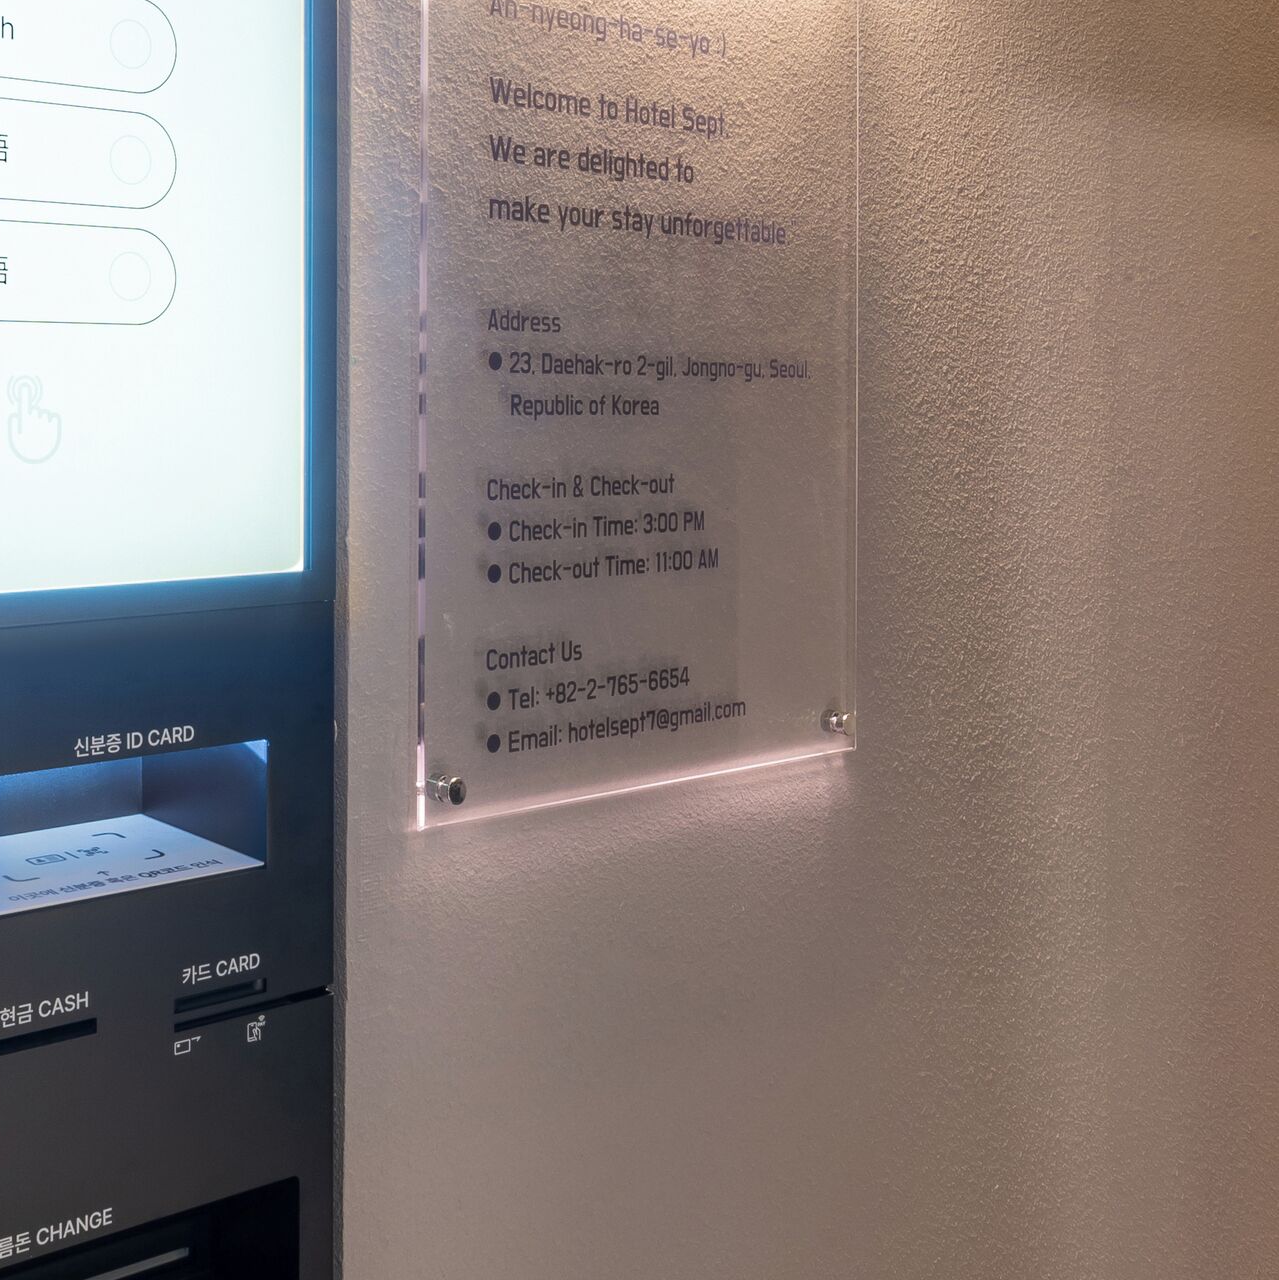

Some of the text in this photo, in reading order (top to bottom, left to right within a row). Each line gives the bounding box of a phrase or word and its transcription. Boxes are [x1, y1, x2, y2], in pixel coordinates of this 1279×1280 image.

[489, 76, 591, 117] Welcome
[598, 93, 619, 121] to
[625, 97, 676, 129] Hotel
[489, 134, 694, 183] We are delighted to
[489, 196, 550, 224] make
[557, 204, 605, 232] your
[612, 205, 654, 239] stay
[488, 308, 562, 333] Address
[541, 352, 632, 376] Daehak-ro
[510, 393, 660, 421] Republic of Korea
[487, 473, 676, 501] Check-in & Check-out
[508, 510, 706, 542] Check-in Time: 3:00 PM
[508, 548, 719, 584] Check-out Time: 11:00 AM
[486, 640, 583, 671] Contact Us
[508, 666, 690, 710] Tel: +82-2-765-6654
[74, 725, 195, 758] 신분증 ID CARD
[508, 700, 747, 753] Email: hotelsept7@gmail.com
[182, 953, 260, 985] 카드 CARD
[0, 991, 89, 1028] 현금 CASH
[35, 1207, 113, 1246] CHANGE
